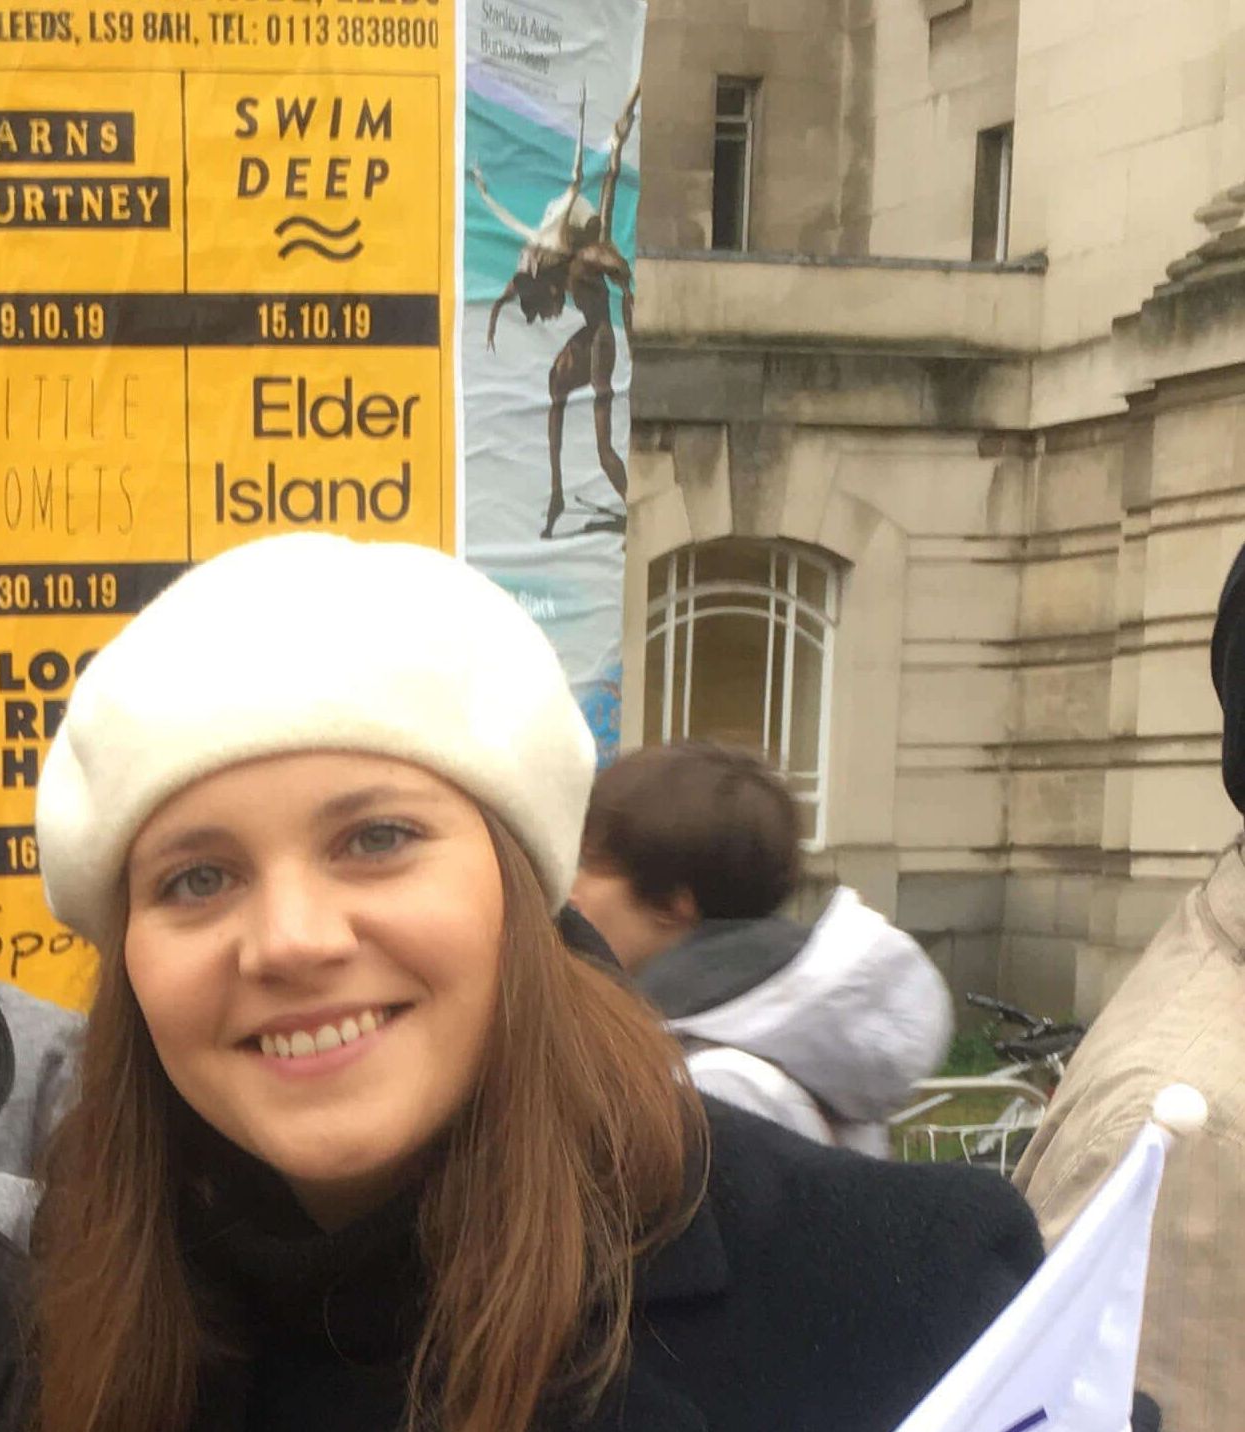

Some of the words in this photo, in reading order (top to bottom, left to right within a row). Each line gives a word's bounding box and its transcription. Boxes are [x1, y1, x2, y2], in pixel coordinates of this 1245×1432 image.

[89, 11, 134, 43] LS9
[142, 11, 200, 46] 8AH,
[208, 12, 258, 46] TEL:
[266, 14, 331, 46] 0113
[337, 14, 440, 49] 3838800
[234, 96, 393, 141] SWIM
[236, 156, 391, 200] DEEP
[0, 302, 105, 340] 9.10.19
[257, 301, 372, 340] 15.10.19
[252, 374, 422, 441] Elder
[215, 460, 411, 525] Island
